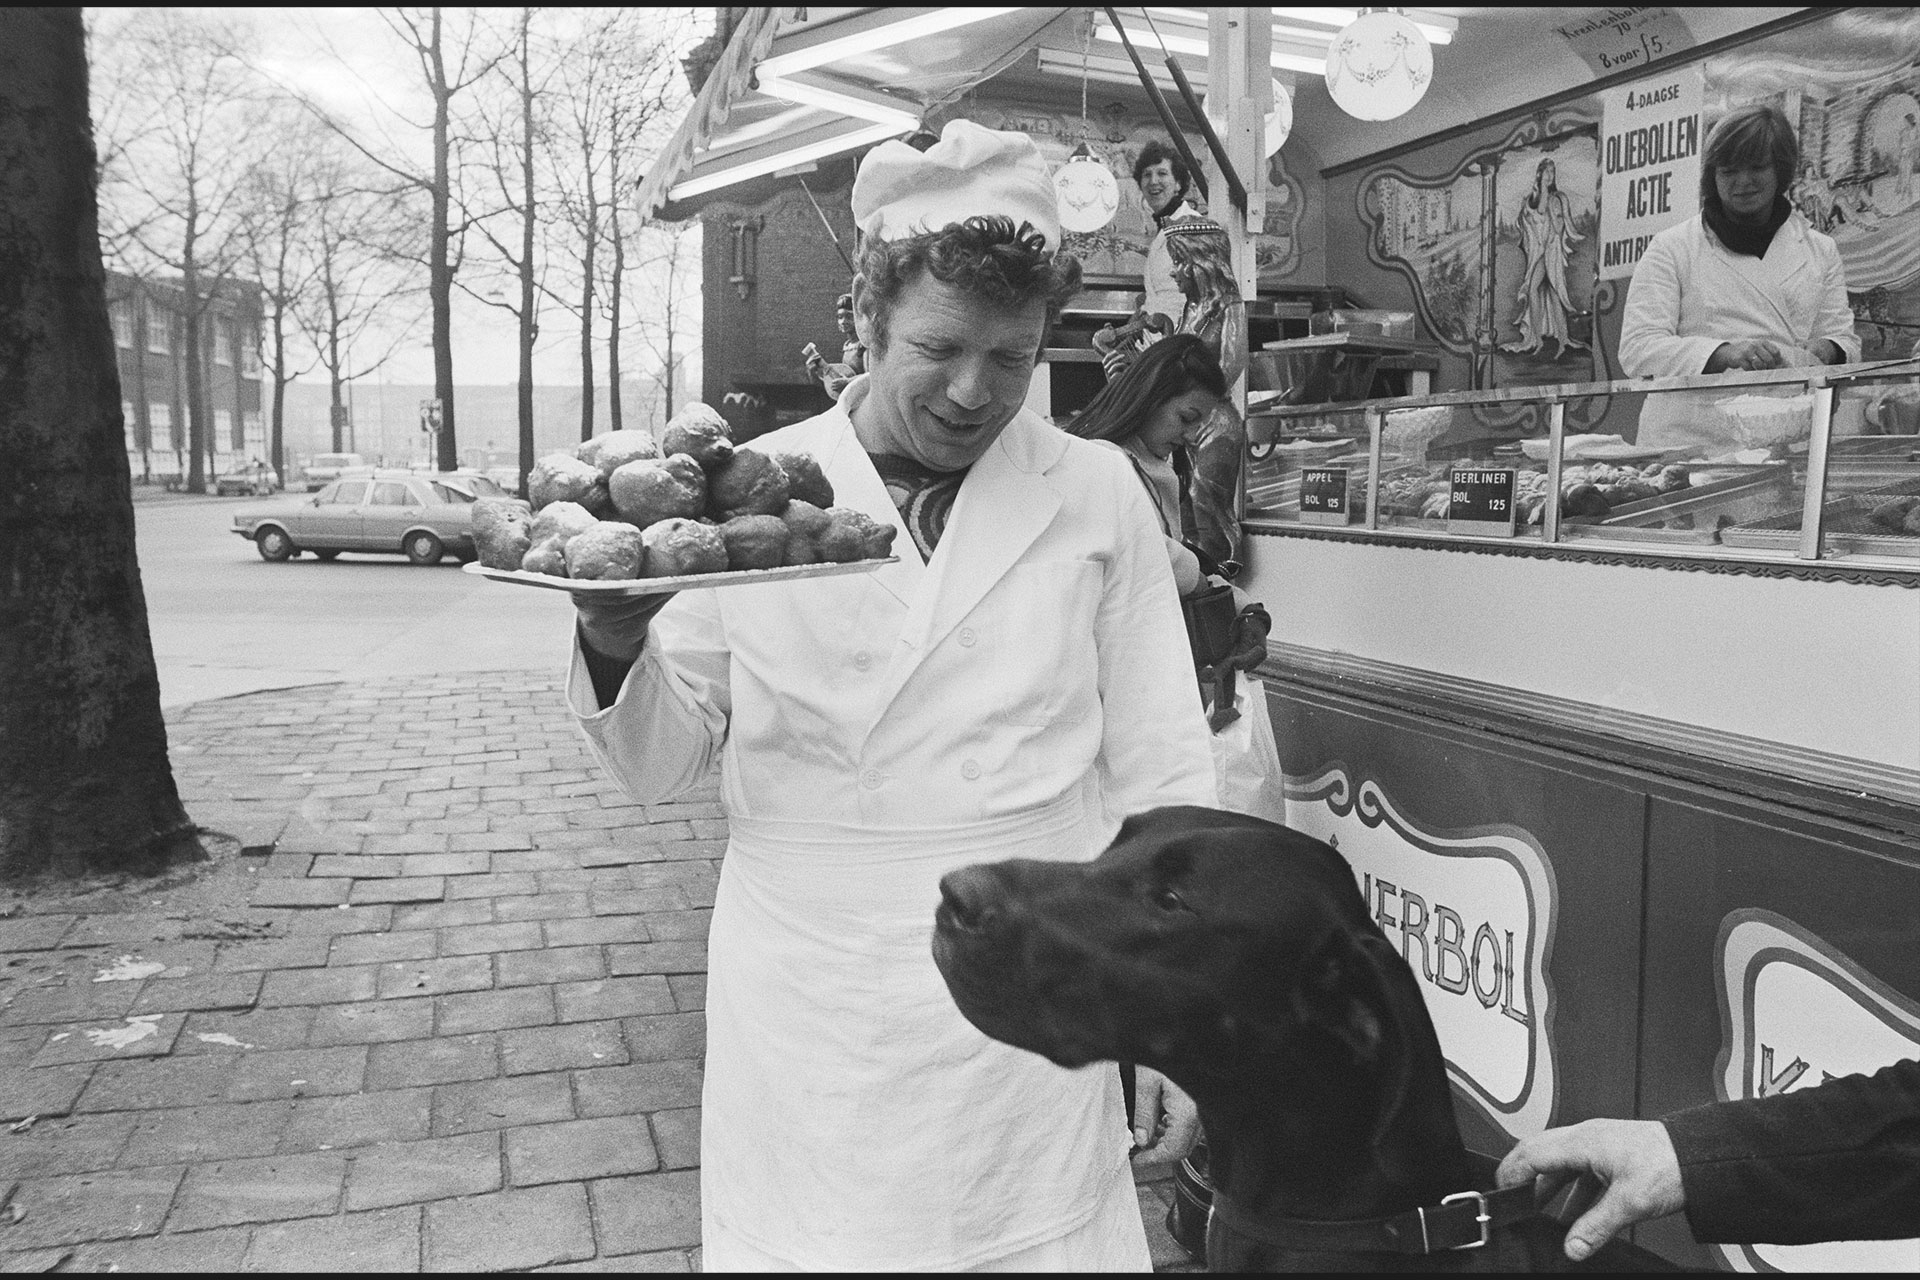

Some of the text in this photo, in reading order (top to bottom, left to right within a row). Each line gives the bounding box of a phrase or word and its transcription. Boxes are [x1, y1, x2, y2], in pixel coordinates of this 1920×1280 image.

[1611, 21, 1632, 36] 70
[1599, 52, 1612, 69] 8
[1612, 48, 1640, 65] voor
[1626, 84, 1680, 111] 4-DAAGSE
[1606, 113, 1698, 175] OLIEBOLLEN
[1626, 171, 1672, 220] ACTIE
[1306, 472, 1332, 483] APPEL
[1454, 472, 1507, 484] BERLINER
[1304, 494, 1320, 505] BOL
[1327, 497, 1339, 508] 125
[1453, 491, 1471, 504] BOL
[1488, 499, 1506, 511] 125
